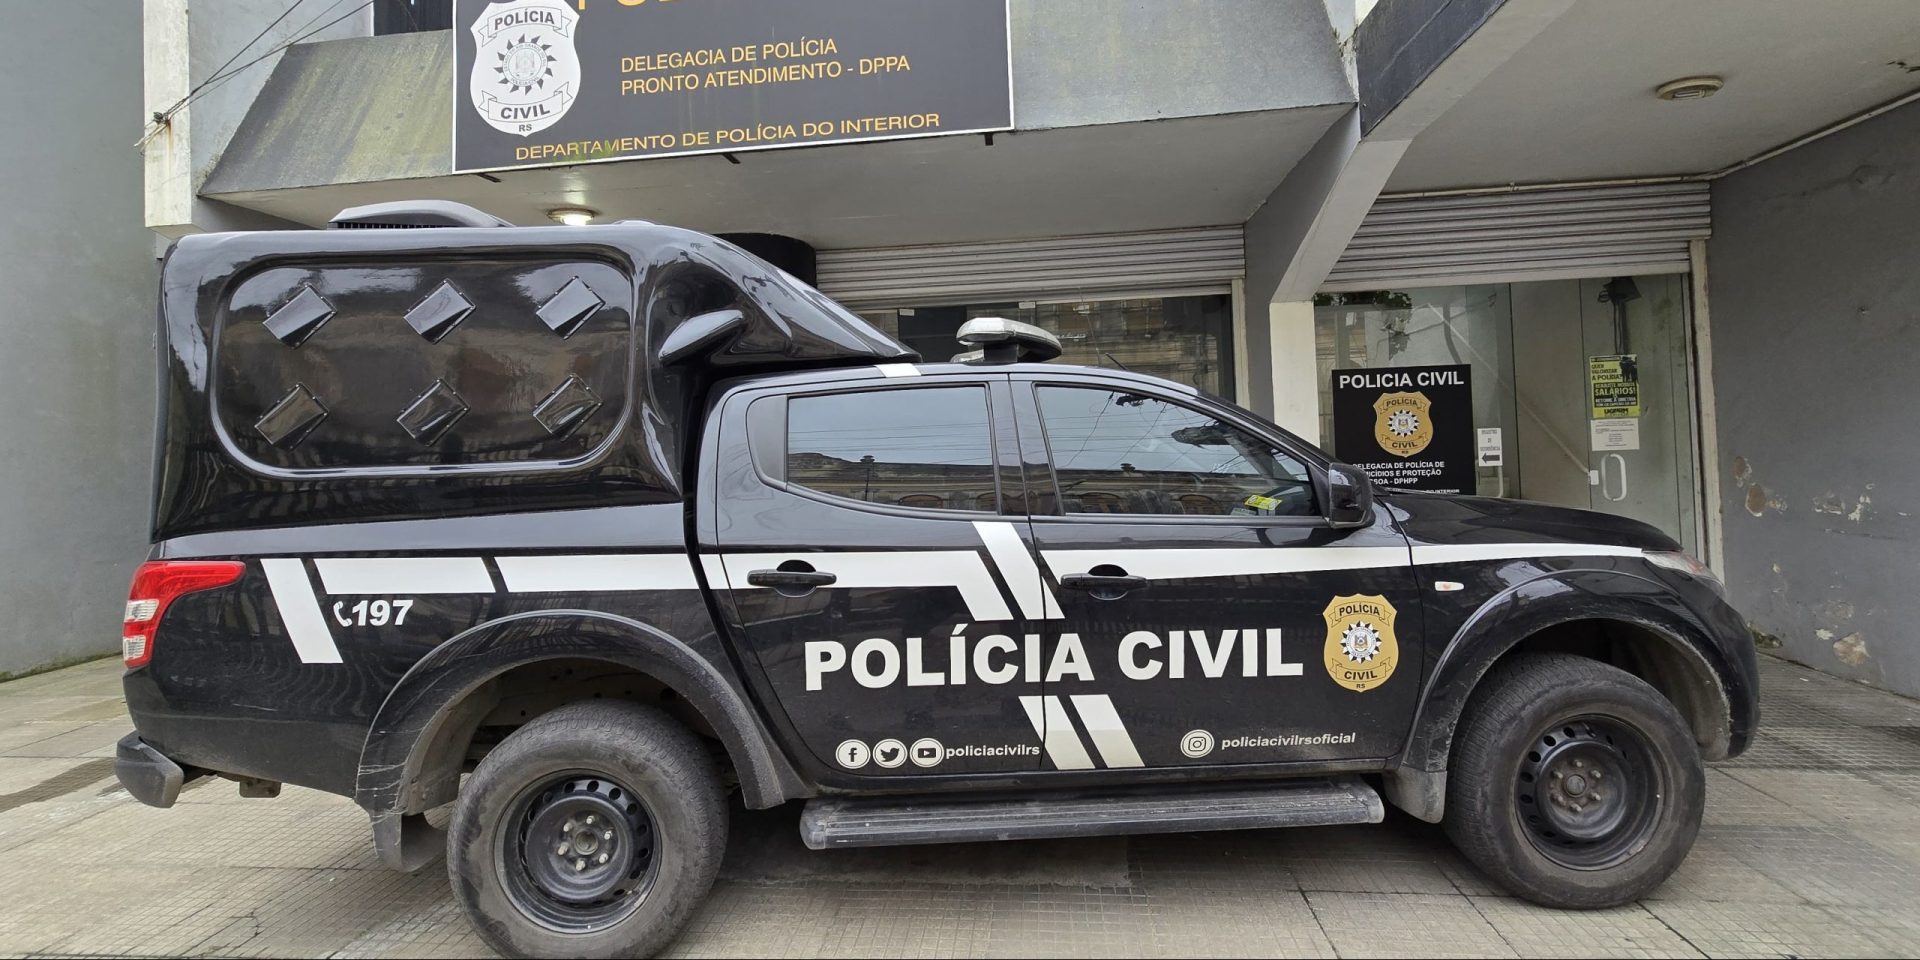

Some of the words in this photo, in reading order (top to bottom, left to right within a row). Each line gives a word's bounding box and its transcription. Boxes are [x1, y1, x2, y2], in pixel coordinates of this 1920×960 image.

[495, 8, 555, 31] POLÍCIA
[621, 48, 726, 73] DELEGACIA
[731, 45, 757, 62] DE
[763, 36, 838, 60] POLÍCIA
[621, 74, 699, 95] PRONTO
[704, 61, 842, 88] ATENDIMENTO
[860, 55, 911, 75] DPPA
[500, 104, 551, 120] CIVIL
[518, 124, 533, 132] RS
[516, 134, 676, 161] DEPARTAMENTO
[682, 131, 709, 147] DE
[716, 122, 797, 144] POLÍCIA
[803, 121, 835, 138] DO
[841, 113, 941, 135] INTERIOR
[1339, 372, 1413, 389] POLICIA
[1417, 371, 1465, 387] CIVIL
[1386, 397, 1418, 407] POLÍCIA
[1402, 468, 1442, 477] PROTEÇÃO
[1405, 461, 1434, 469] POLÍCIA
[352, 600, 414, 626] 197
[1339, 603, 1380, 616] POLÍCIA
[805, 623, 1095, 691] POLÍCIA
[1118, 628, 1303, 680] CIVIL
[1344, 671, 1378, 680] CIVIL
[1221, 732, 1356, 750] policiacivilrsoficial
[946, 744, 1040, 759] policiacivilrs
